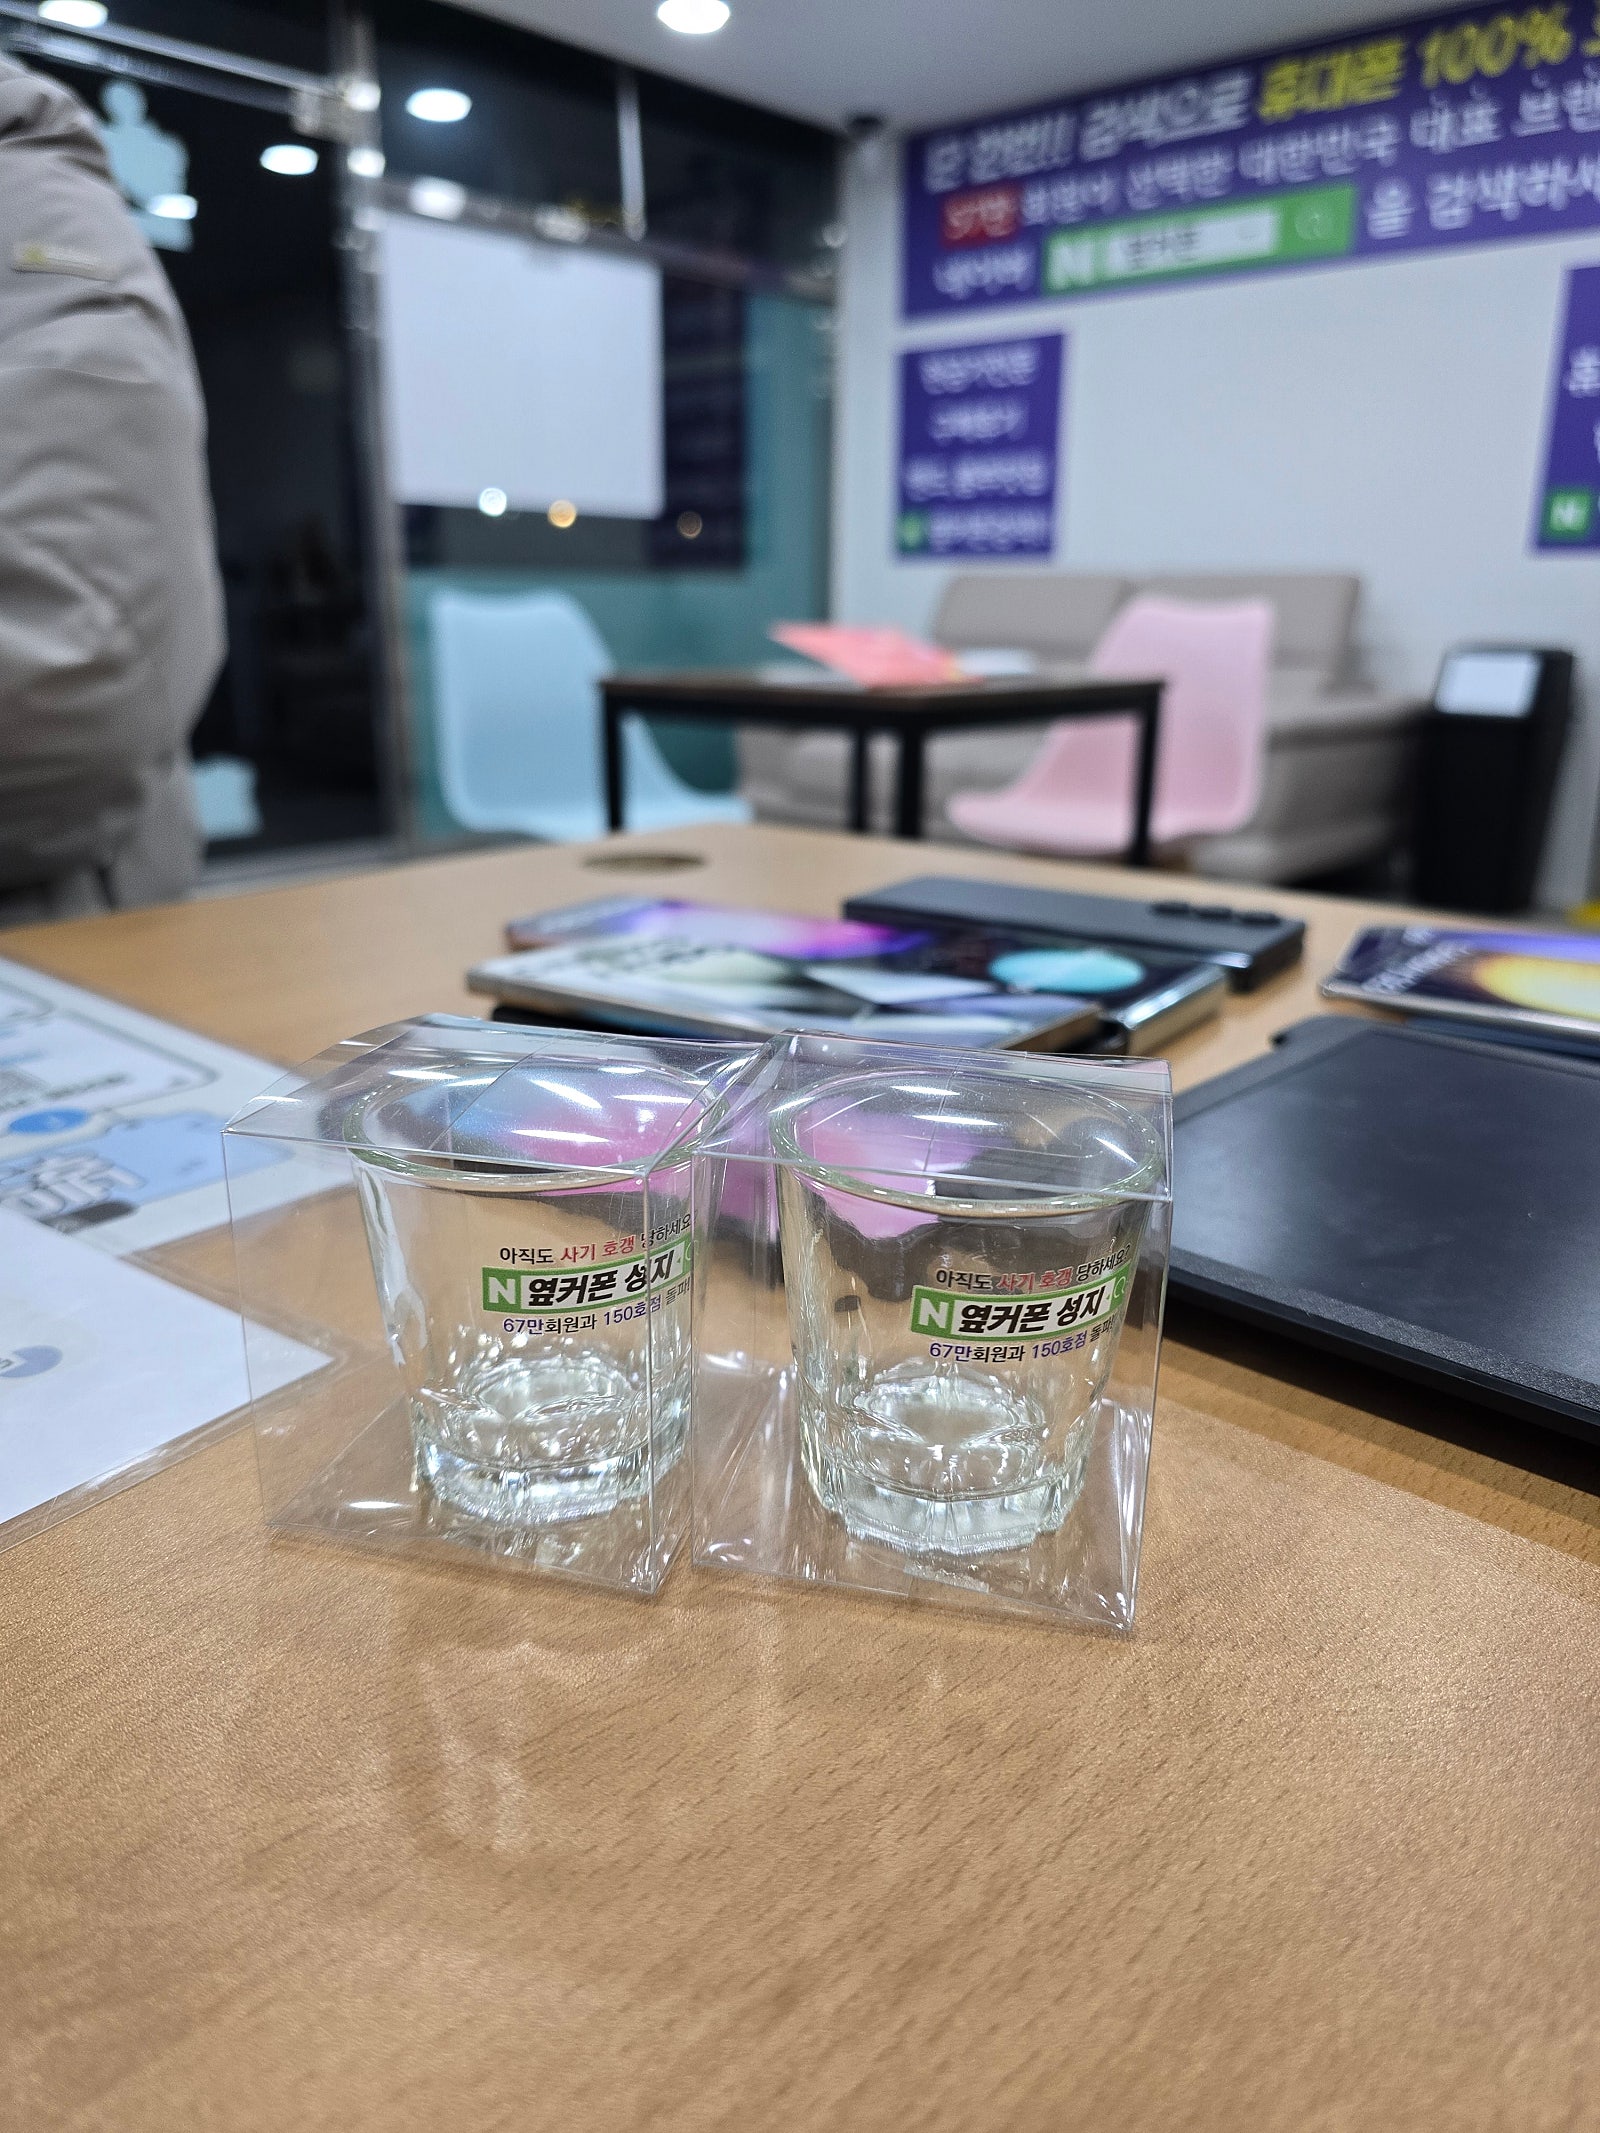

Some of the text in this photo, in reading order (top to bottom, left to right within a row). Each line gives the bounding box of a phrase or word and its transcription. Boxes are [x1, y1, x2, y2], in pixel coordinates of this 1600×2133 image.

[1257, 38, 1405, 122] 휴대폰
[1417, 5, 1572, 88] 100%
[1238, 115, 1400, 186] 대한민국
[500, 1247, 554, 1265] 아직도
[560, 1243, 596, 1263] 사기
[602, 1236, 635, 1257] 호갱
[936, 1244, 1131, 1291] 아직도 사기 호갱 당하세요?
[488, 1250, 675, 1307] N 옆커폰 성지
[503, 1314, 597, 1335] 67만회원과
[603, 1294, 662, 1325] 150호점
[918, 1285, 1106, 1334] N 옆커폰 성지
[929, 1343, 1025, 1363] 67만회원과
[1031, 1330, 1088, 1359] 150호점
